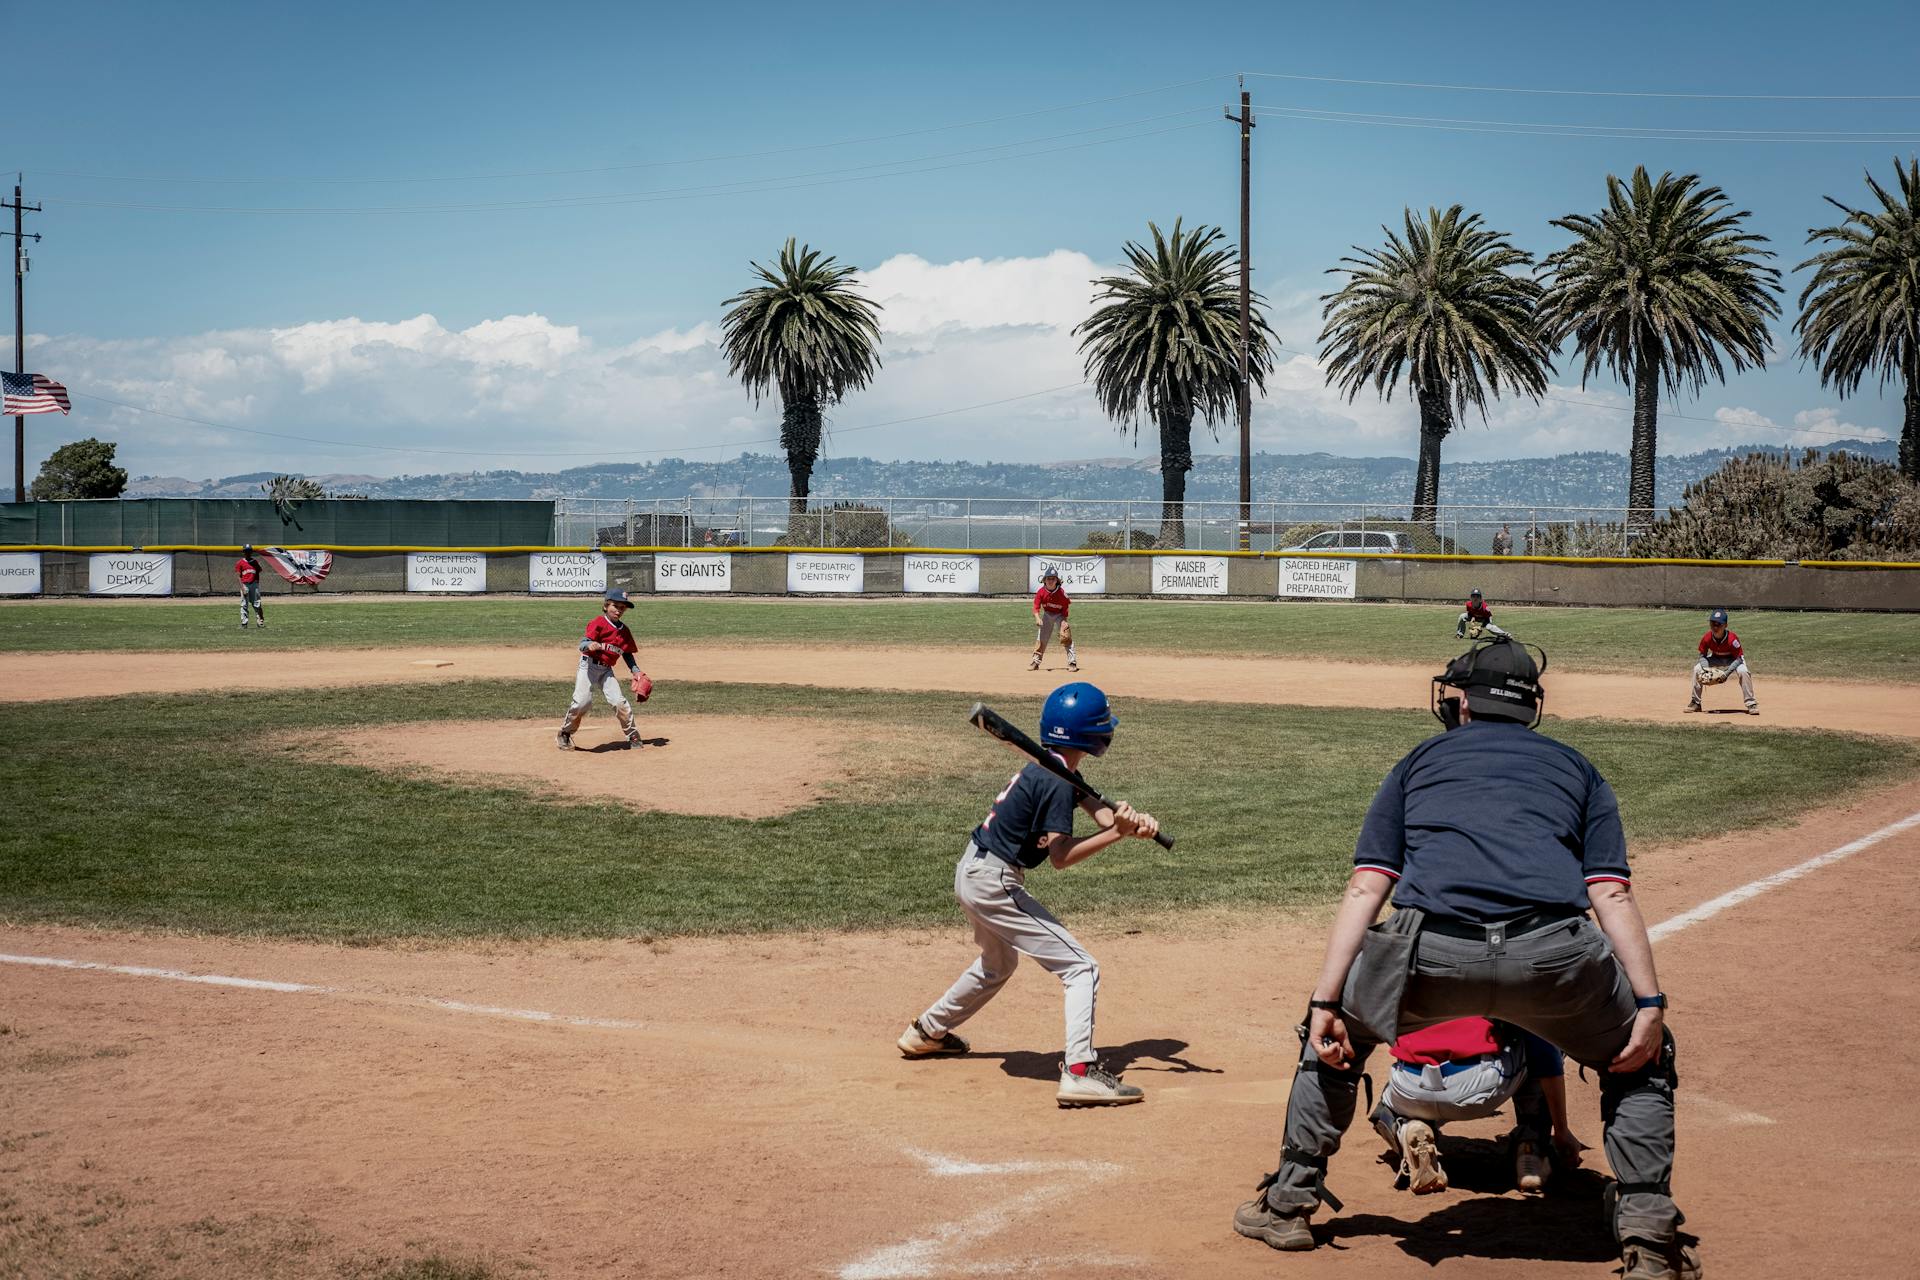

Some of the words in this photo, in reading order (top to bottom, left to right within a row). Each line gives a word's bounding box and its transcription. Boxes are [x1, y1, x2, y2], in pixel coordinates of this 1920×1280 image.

[416, 555, 478, 563] CARPENTERS
[541, 555, 595, 565] CUCALON
[108, 560, 153, 571] YOUNG
[415, 566, 446, 575] LOCAL
[447, 566, 477, 575] UNION
[661, 564, 677, 577] SF
[680, 564, 725, 577] GIANTS
[796, 562, 807, 570] SF
[809, 562, 856, 571] PEDIATRIC
[908, 561, 938, 570] HARD
[942, 561, 973, 571] ROCK
[1075, 562, 1095, 571] RIO
[1175, 560, 1206, 574] KAISER
[1285, 560, 1320, 570] SACRED
[1322, 561, 1350, 571] HEART
[0, 568, 35, 576] URGER
[546, 567, 554, 577] &
[556, 567, 590, 577] MATIN
[1292, 572, 1342, 582] CATHEDRAL
[107, 574, 154, 585] DENTAL
[432, 577, 448, 586] No.
[450, 577, 463, 586] 22
[801, 573, 851, 582] DENTISTRY
[927, 572, 956, 584] CAFÉ
[1067, 575, 1074, 584] &
[1077, 575, 1098, 584] TEA
[1161, 575, 1219, 588] PERMANENTE
[532, 580, 604, 588] ORTHODONTICS
[1286, 584, 1348, 594] PREPARATORY
